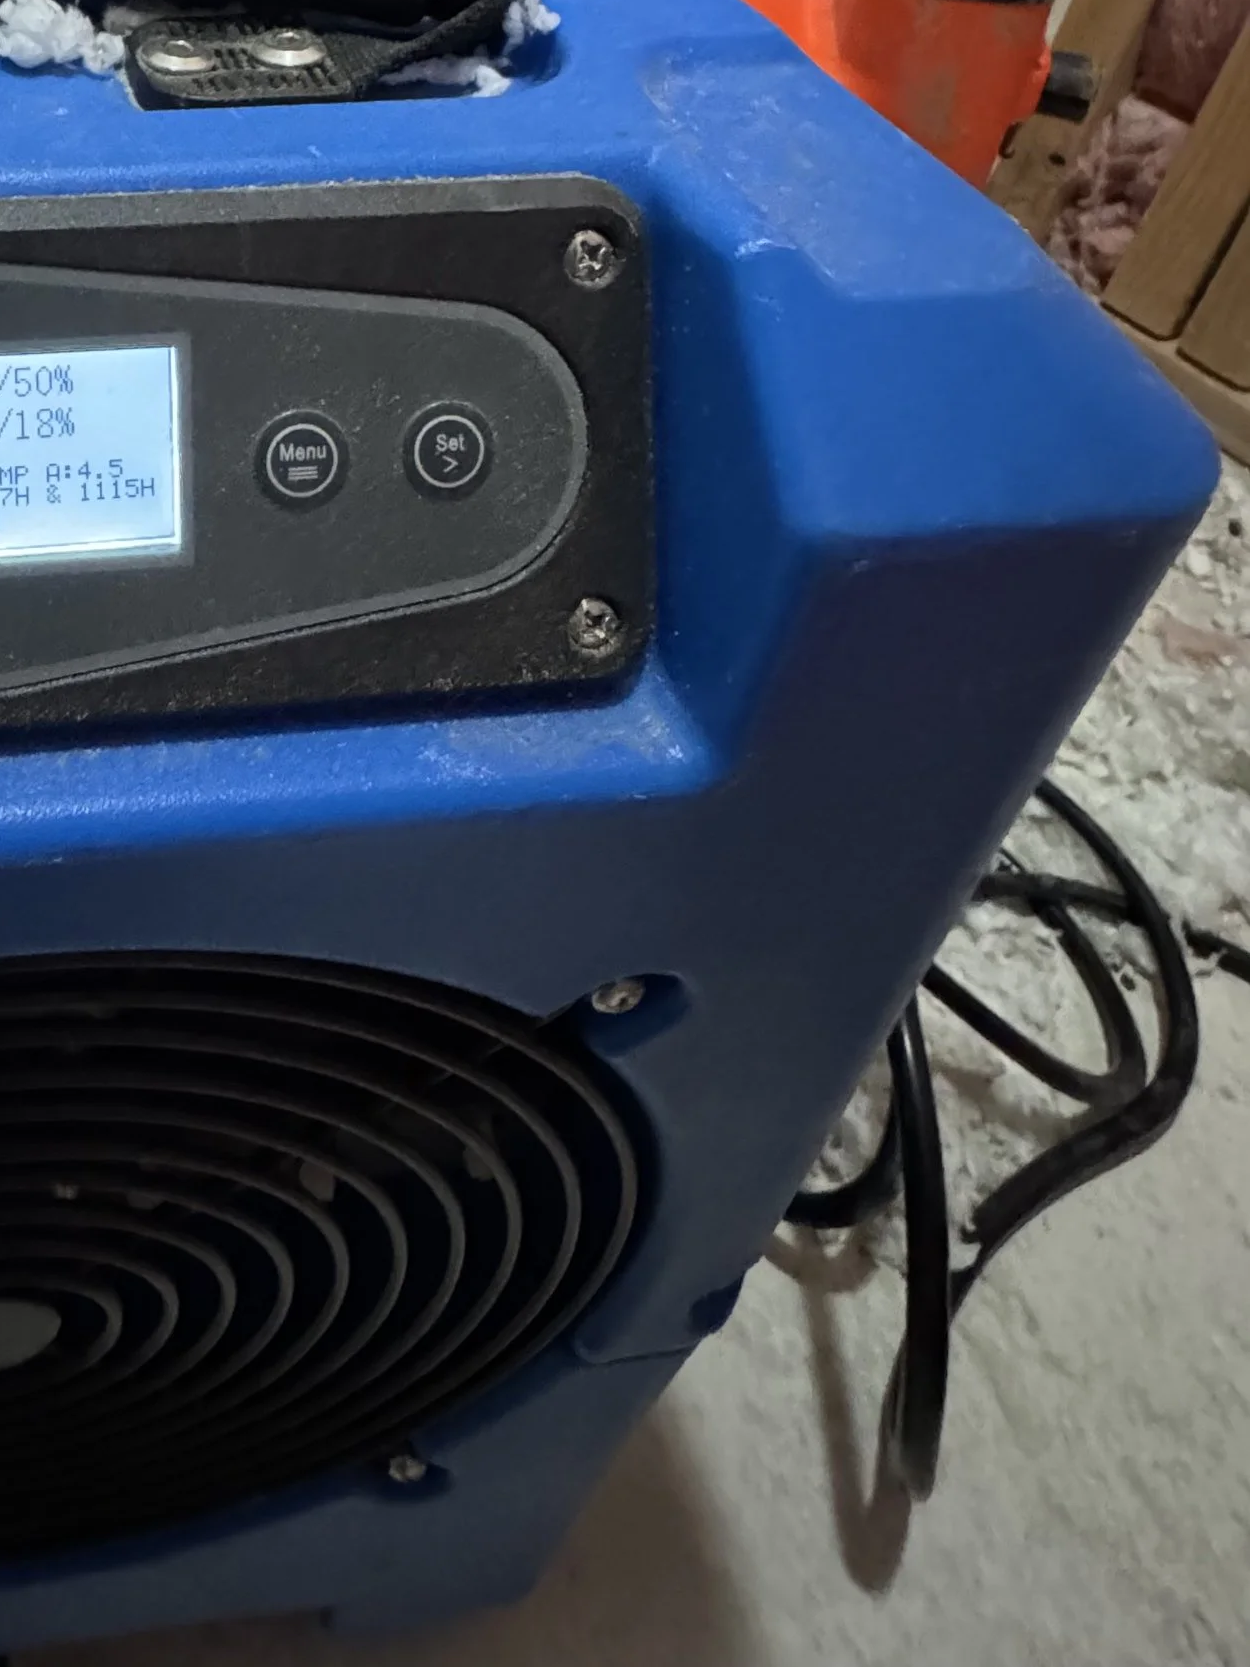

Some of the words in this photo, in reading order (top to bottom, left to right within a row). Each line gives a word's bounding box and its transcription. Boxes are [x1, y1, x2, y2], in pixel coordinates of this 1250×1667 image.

[278, 442, 328, 463] Menu
[434, 433, 466, 453] Set
[45, 458, 124, 485] A:4.5
[46, 483, 62, 505] &
[80, 477, 156, 502] 1115H
